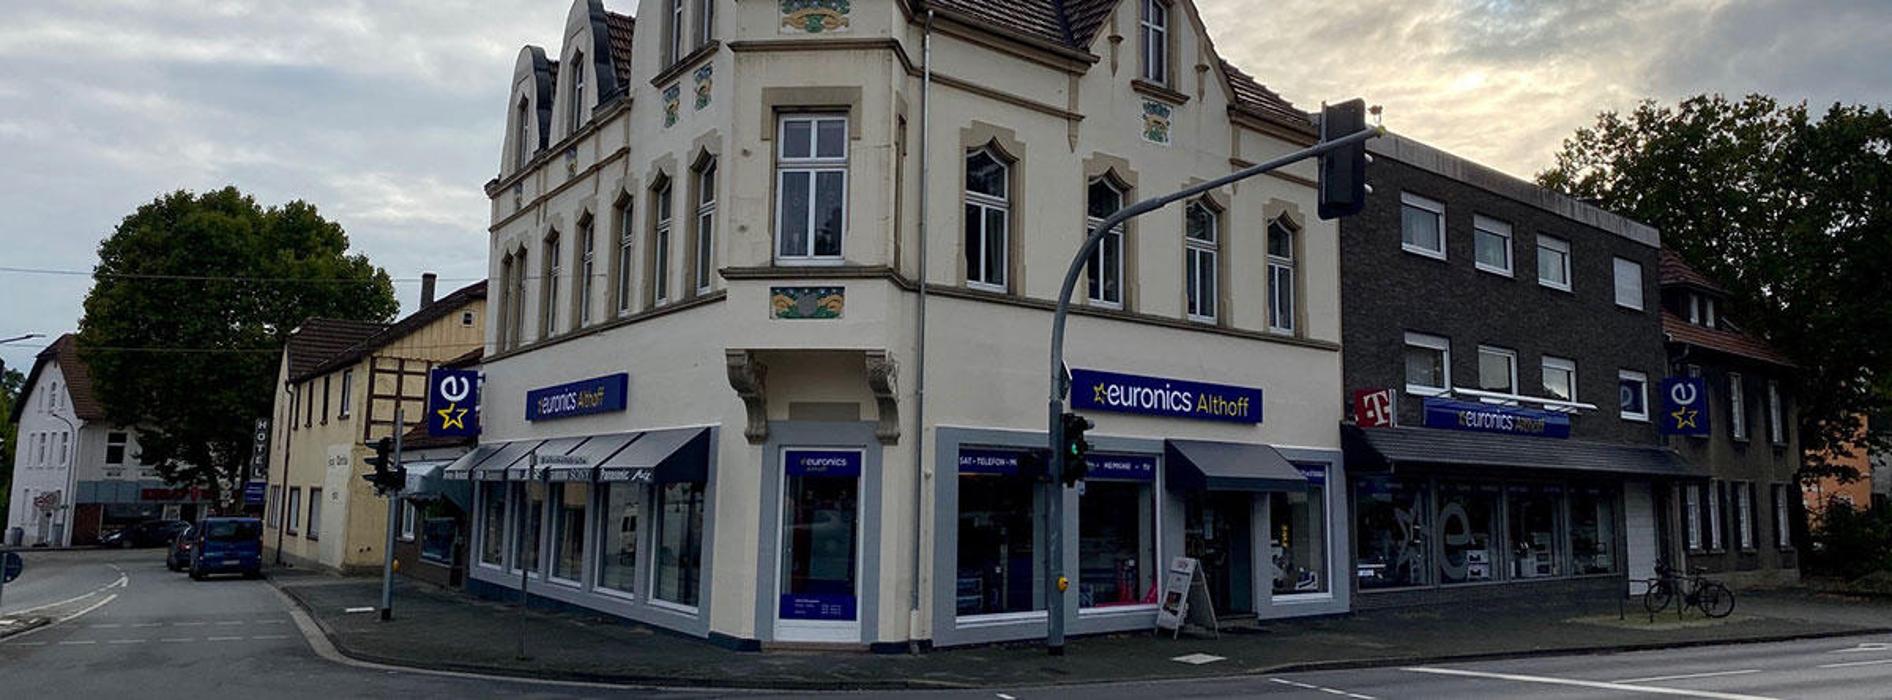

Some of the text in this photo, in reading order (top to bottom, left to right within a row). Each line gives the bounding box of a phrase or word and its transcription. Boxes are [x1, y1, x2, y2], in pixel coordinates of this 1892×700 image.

[440, 375, 470, 402] e
[542, 388, 578, 415] euronics
[1106, 383, 1250, 417] euronics Althoff
[1670, 383, 1697, 405] e
[1465, 409, 1514, 430] euronics
[255, 419, 268, 478] HOTEL
[806, 458, 847, 467] euronics
